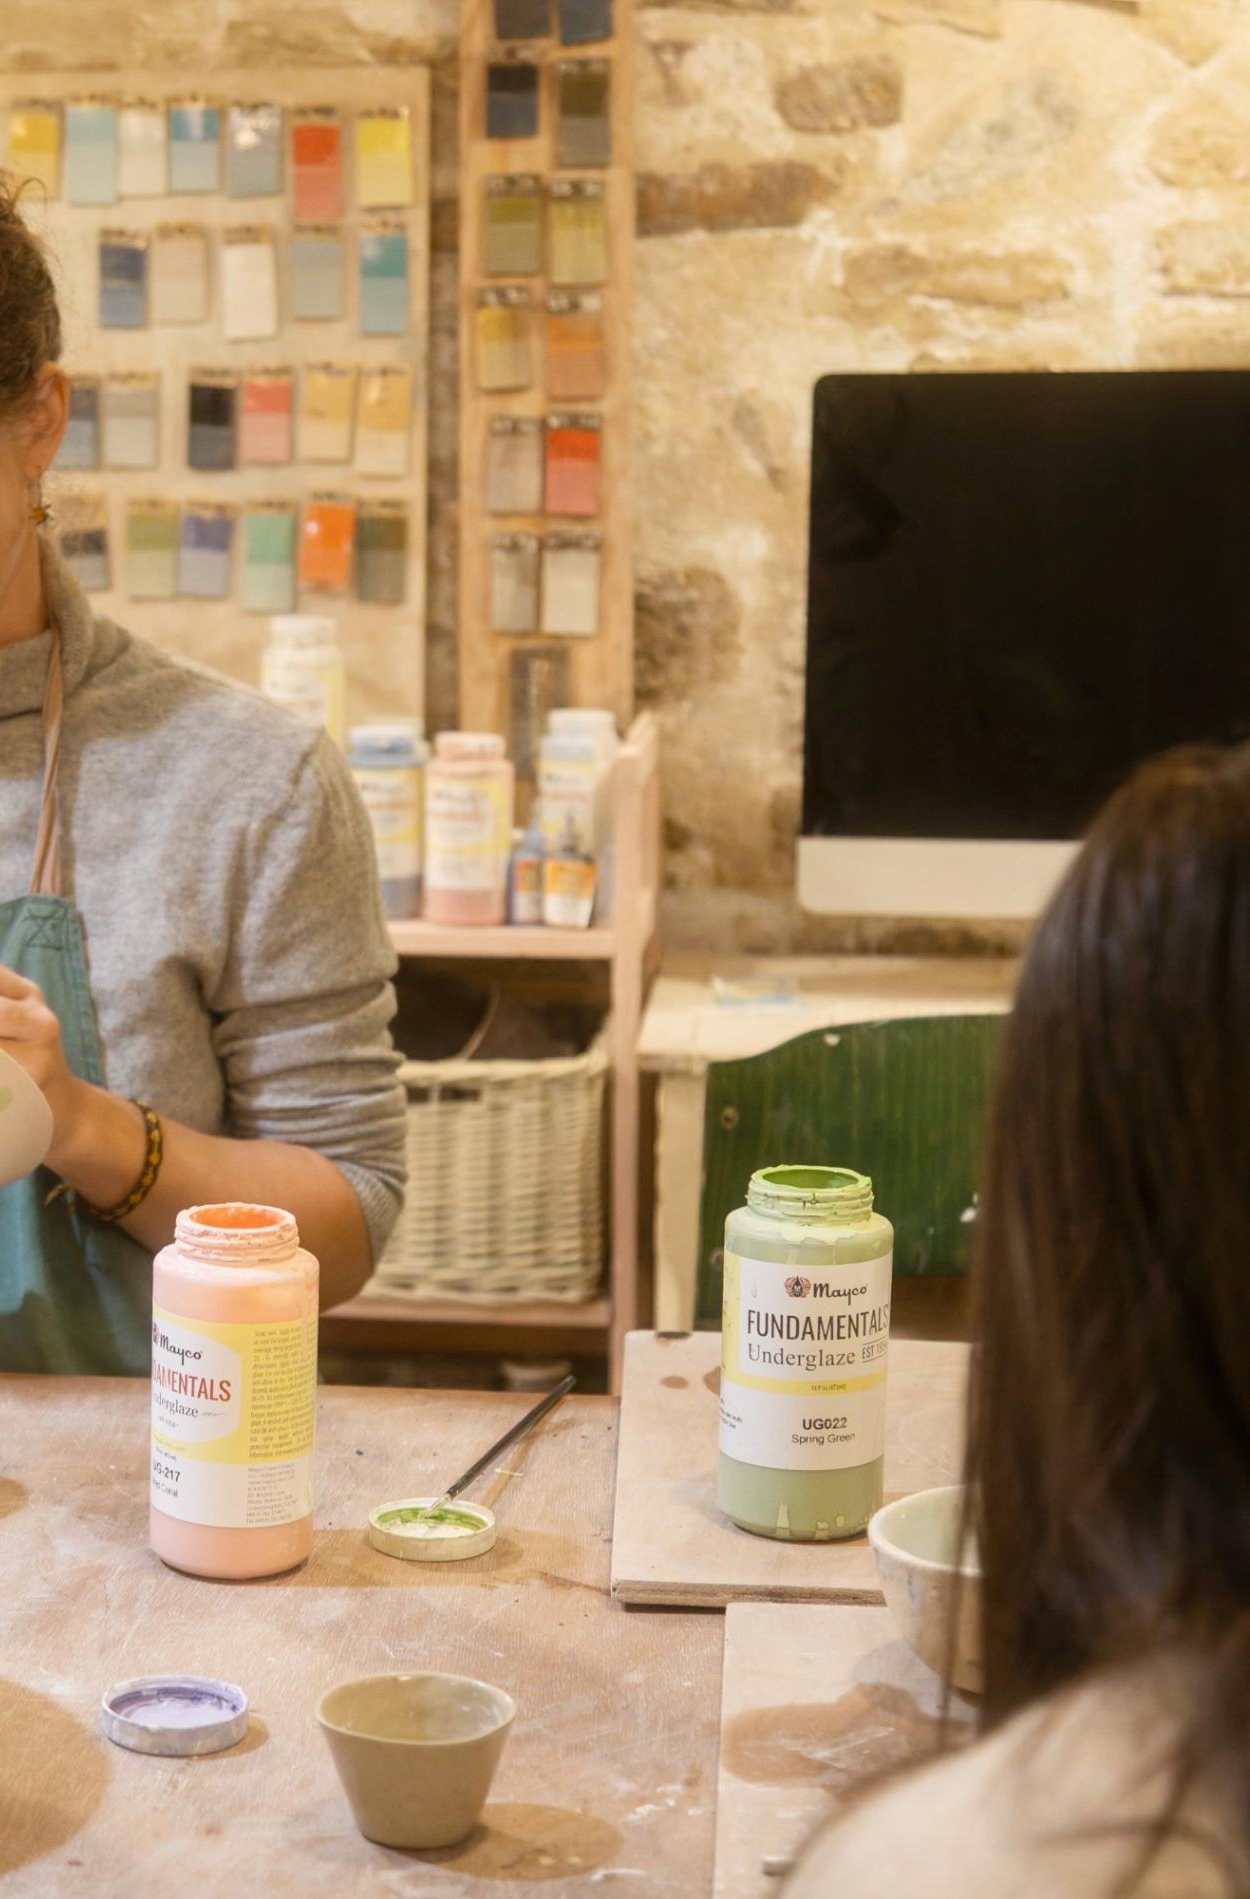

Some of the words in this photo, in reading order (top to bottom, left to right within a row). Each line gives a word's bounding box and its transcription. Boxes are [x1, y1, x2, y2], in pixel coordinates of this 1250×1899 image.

[813, 1283, 867, 1307] Mayco
[747, 1304, 889, 1342] FUNDAMENTALS
[160, 1333, 203, 1367] Mayco
[748, 1343, 856, 1372] Underglaze
[802, 1416, 848, 1431] UG022
[791, 1433, 826, 1446] Spring
[827, 1432, 856, 1444] Green
